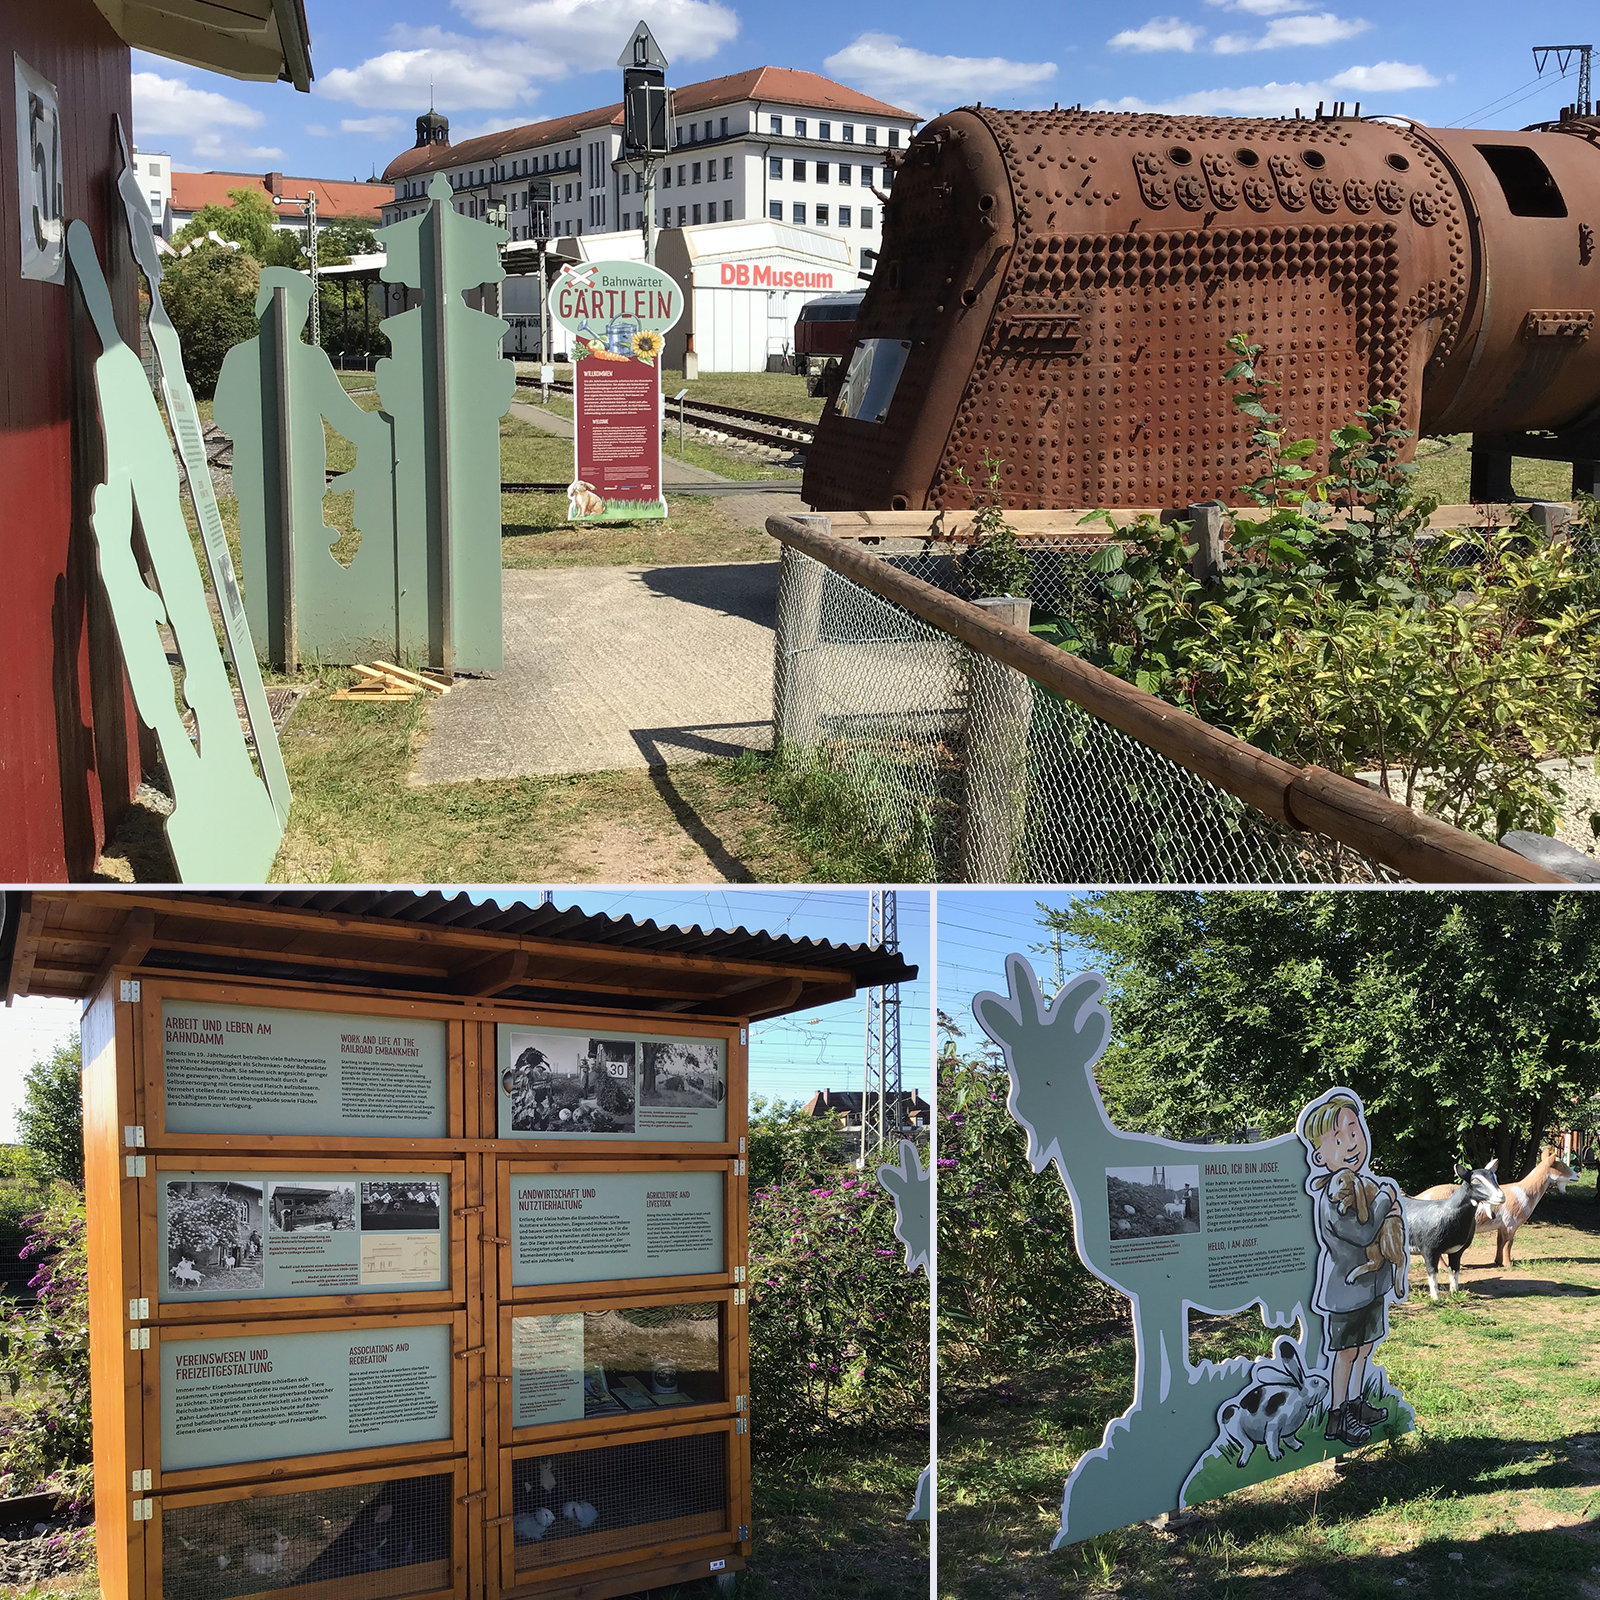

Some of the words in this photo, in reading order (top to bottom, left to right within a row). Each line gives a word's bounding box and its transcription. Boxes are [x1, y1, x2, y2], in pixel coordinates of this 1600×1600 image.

[602, 276, 663, 288] Bahnwärter
[720, 264, 750, 286] DB
[753, 265, 833, 288] Museum
[559, 288, 673, 319] GÄRTLEIN
[166, 1017, 199, 1030] ARBEIT
[202, 1019, 222, 1031] UND
[226, 1021, 253, 1034] LEBEN
[257, 1023, 272, 1035] AM
[166, 1030, 224, 1045] BAHNDAMM
[341, 1034, 360, 1044] WORK
[363, 1036, 376, 1045] AND
[378, 1036, 391, 1045] LIFE
[393, 1038, 401, 1046] AT
[403, 1038, 415, 1047] THE
[341, 1044, 373, 1054] RAILROAD
[375, 1046, 419, 1057] EMBANKMENT
[200, 1059, 242, 1067] Haupttätigkeit
[284, 1056, 326, 1064] Bahnangestellte
[180, 1065, 239, 1073] Kleinlandwirtschaft.
[610, 1064, 624, 1076] 30
[167, 1078, 218, 1088] Selbstversorgung
[222, 1102, 253, 1110] Verfügung.
[1205, 1164, 1229, 1175] HALLO,
[1231, 1163, 1242, 1174] ICH
[1245, 1163, 1257, 1173] BIN
[1259, 1162, 1279, 1173] JOSEF.
[518, 1189, 580, 1199] LANDWIRTSCHAFT
[582, 1188, 596, 1198] UND
[519, 1200, 583, 1211] NUTZTIERHALTUNG
[1208, 1242, 1226, 1251] HELLO,
[1232, 1240, 1240, 1248] AM
[1242, 1238, 1258, 1247] JOSEF.
[349, 1344, 394, 1355] ASSOCIATIONS
[396, 1343, 410, 1352] AND
[176, 1351, 246, 1366] VEREINSWESEN
[250, 1349, 268, 1361] UND
[349, 1354, 387, 1365] RECREATION
[176, 1361, 273, 1380] FREIZEITGESTALTUNG
[212, 1379, 271, 1390] Eisenbahnangestellte
[220, 1389, 252, 1398] gemeinsam
[224, 1395, 246, 1404] gründet
[269, 1389, 307, 1399] Hauptverband
[262, 1398, 290, 1406] entwickelt
[176, 1421, 193, 1430] grund
[194, 1418, 229, 1427] befindlichen
[230, 1412, 287, 1423] Kleingartenkolonien.
[288, 1408, 319, 1417] Mittlerweile
[290, 1415, 328, 1424] Freizeitgärten.
